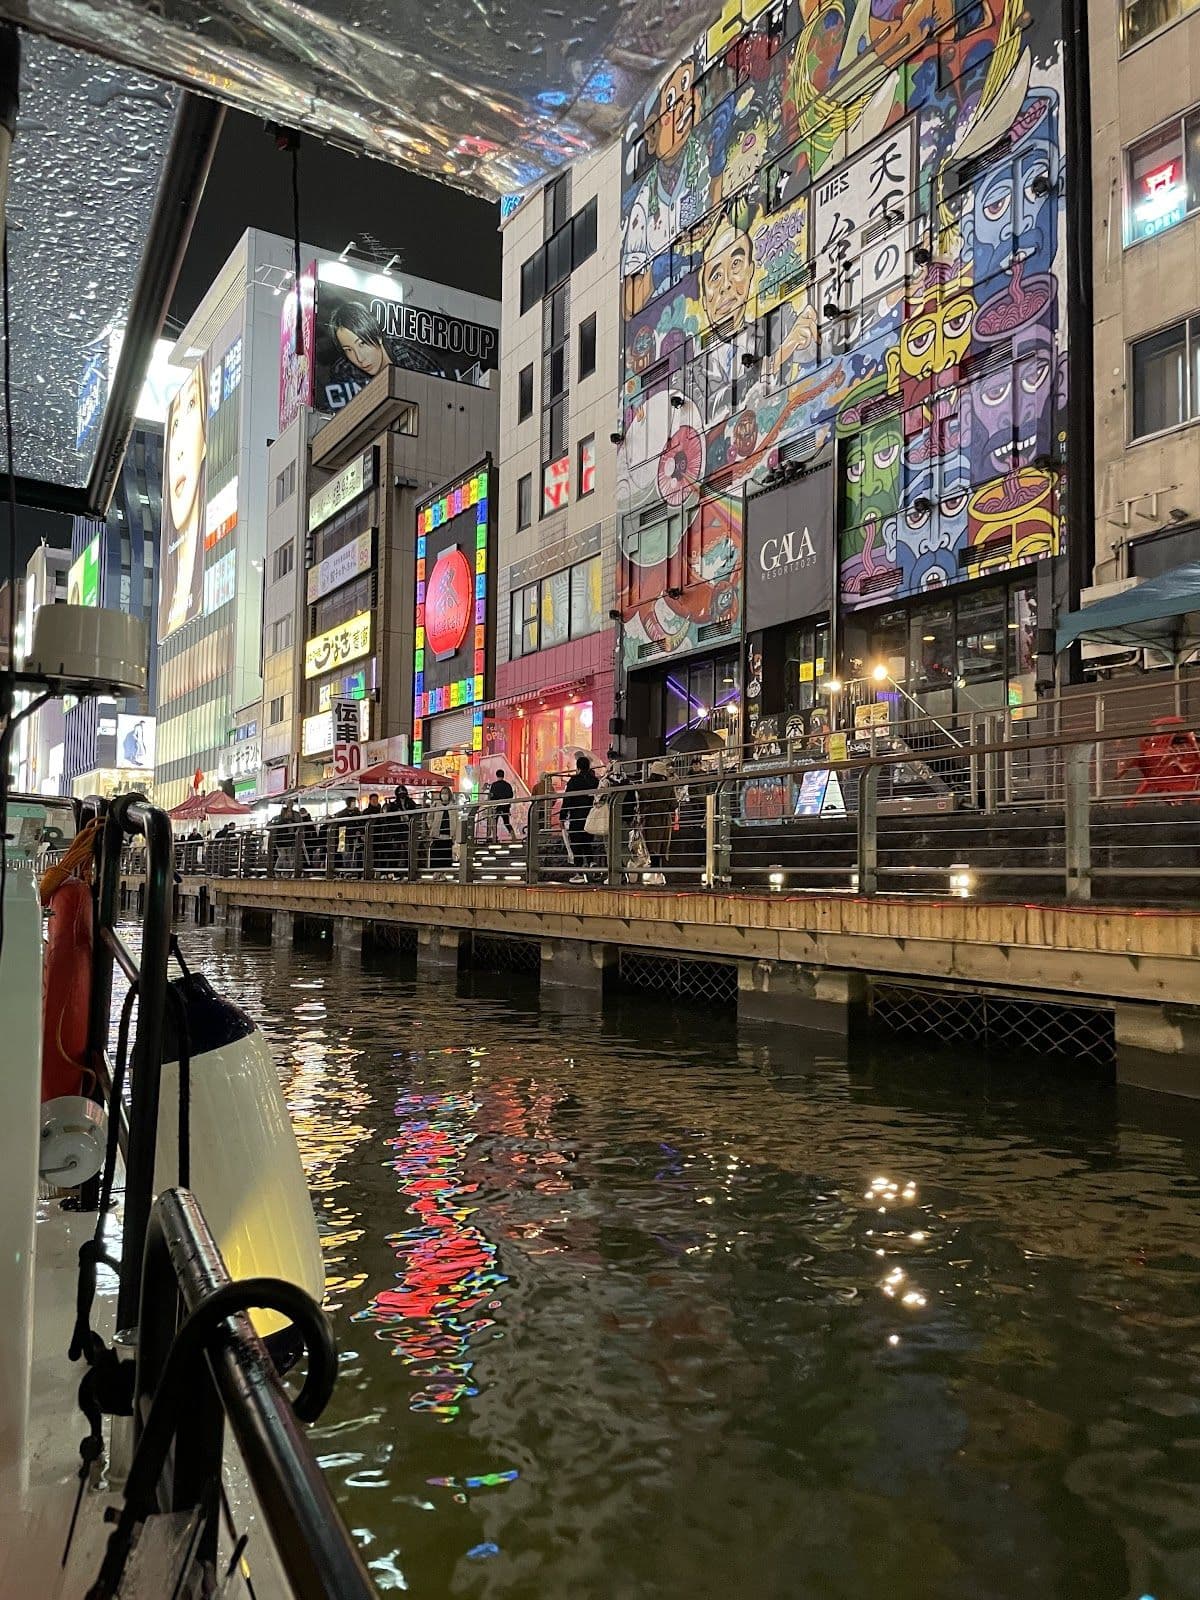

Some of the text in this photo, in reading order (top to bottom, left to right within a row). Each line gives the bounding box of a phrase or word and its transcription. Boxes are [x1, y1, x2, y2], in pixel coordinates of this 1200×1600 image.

[1144, 208, 1182, 236] OPEN
[369, 298, 495, 359] ONEGROUP
[760, 526, 817, 571] GALA
[315, 627, 351, 670] うなぎ
[335, 703, 359, 743] 伝串
[334, 744, 361, 774] 50
